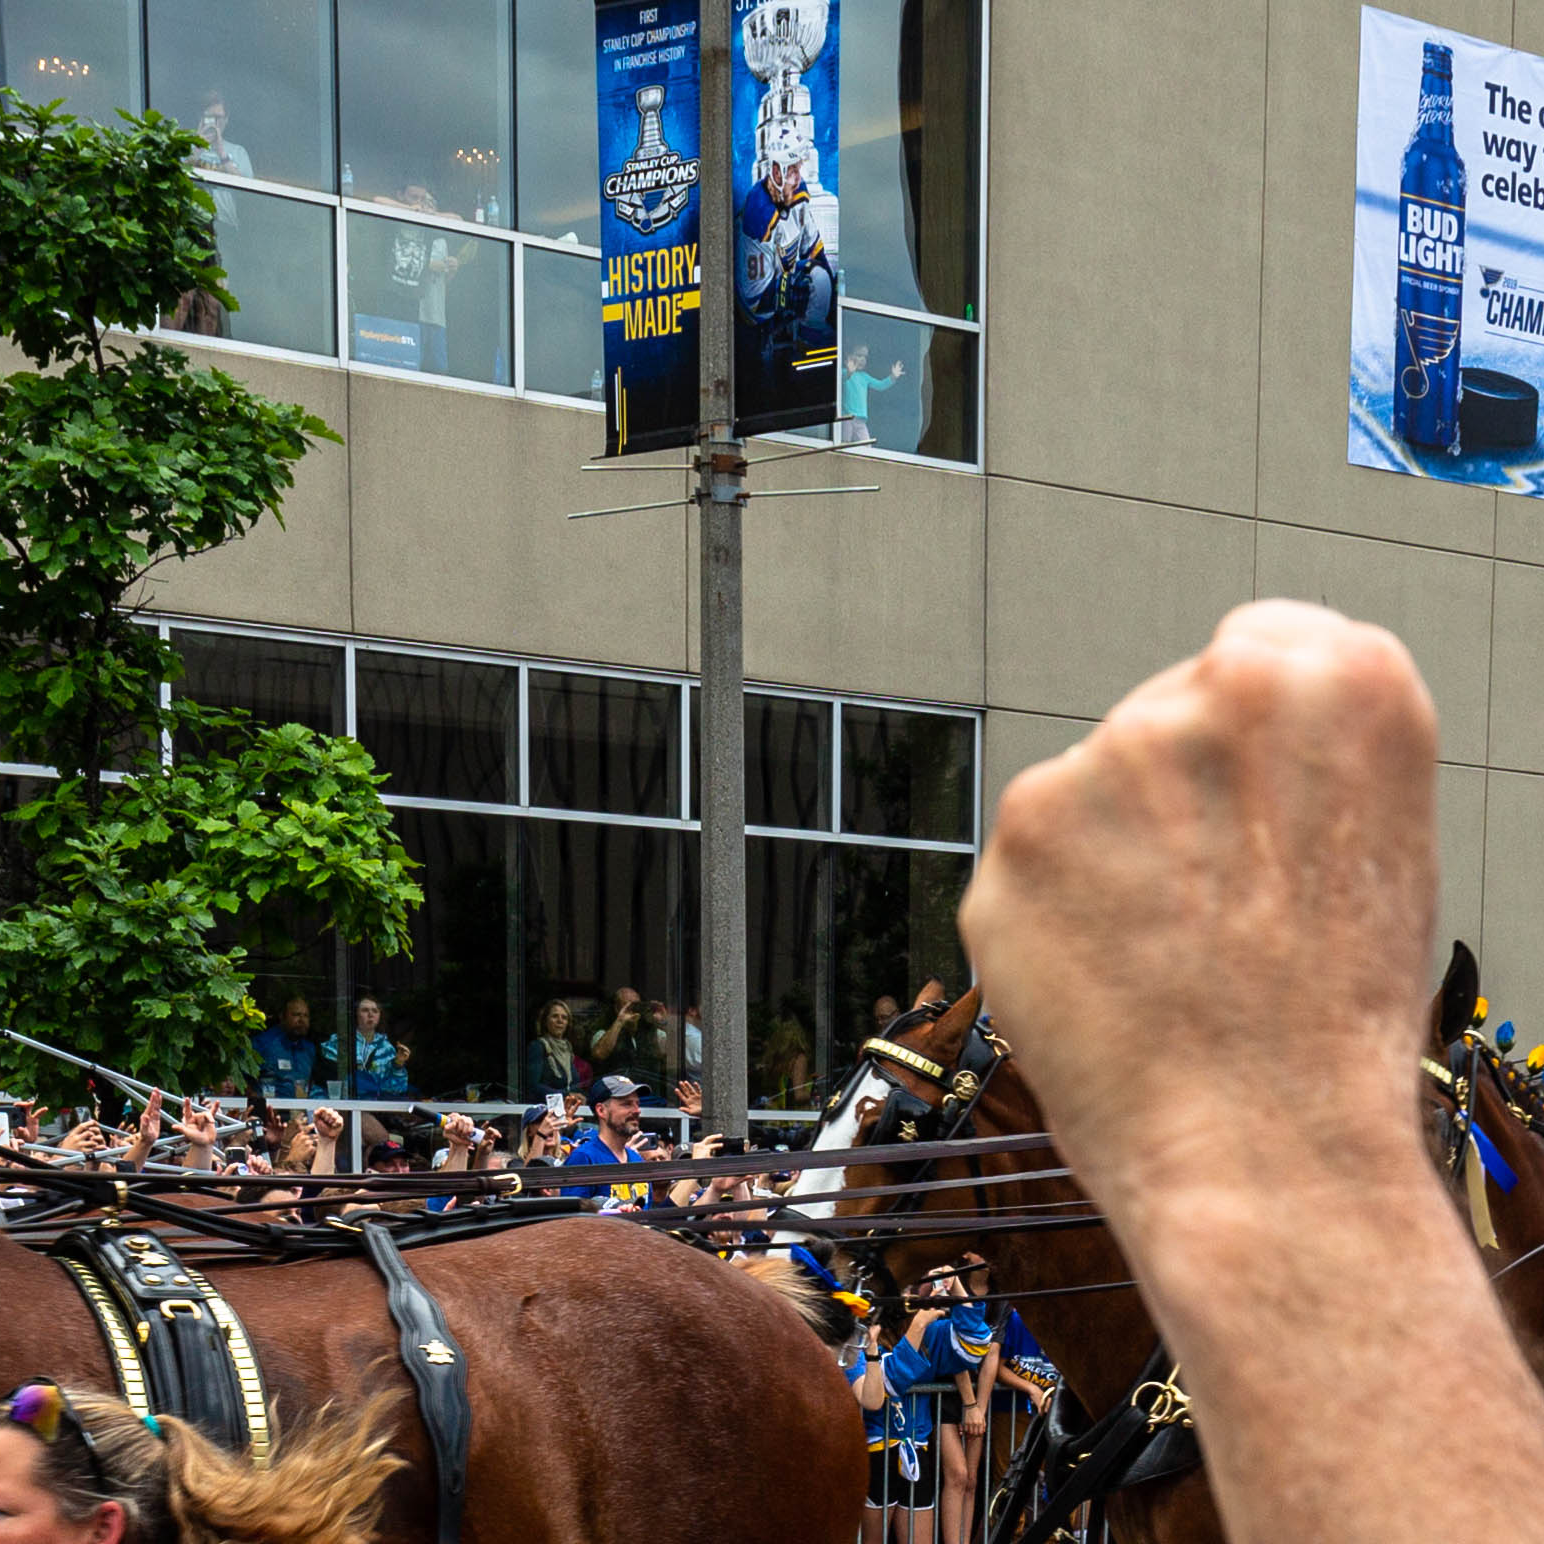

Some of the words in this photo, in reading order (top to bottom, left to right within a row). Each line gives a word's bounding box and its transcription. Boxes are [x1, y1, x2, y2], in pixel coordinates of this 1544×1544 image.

[639, 8, 658, 25] FIRST
[603, 35, 629, 54] STANLEY
[631, 32, 645, 47] CUP
[646, 20, 696, 45] CHAMPIONSHIP
[613, 58, 622, 73] IN
[622, 49, 657, 71] FRANCHISE
[658, 44, 686, 64] HISTORY
[1484, 81, 1532, 125] The
[626, 159, 660, 174] STANLEY
[660, 155, 679, 167] CUP
[1482, 131, 1537, 173] way
[606, 161, 698, 195] CHAMPIONS
[1406, 203, 1459, 244] BUD
[609, 242, 698, 297] HISTORY
[1399, 232, 1465, 275] LIGHT
[1502, 276, 1518, 290] 2019
[624, 292, 683, 342] MADE
